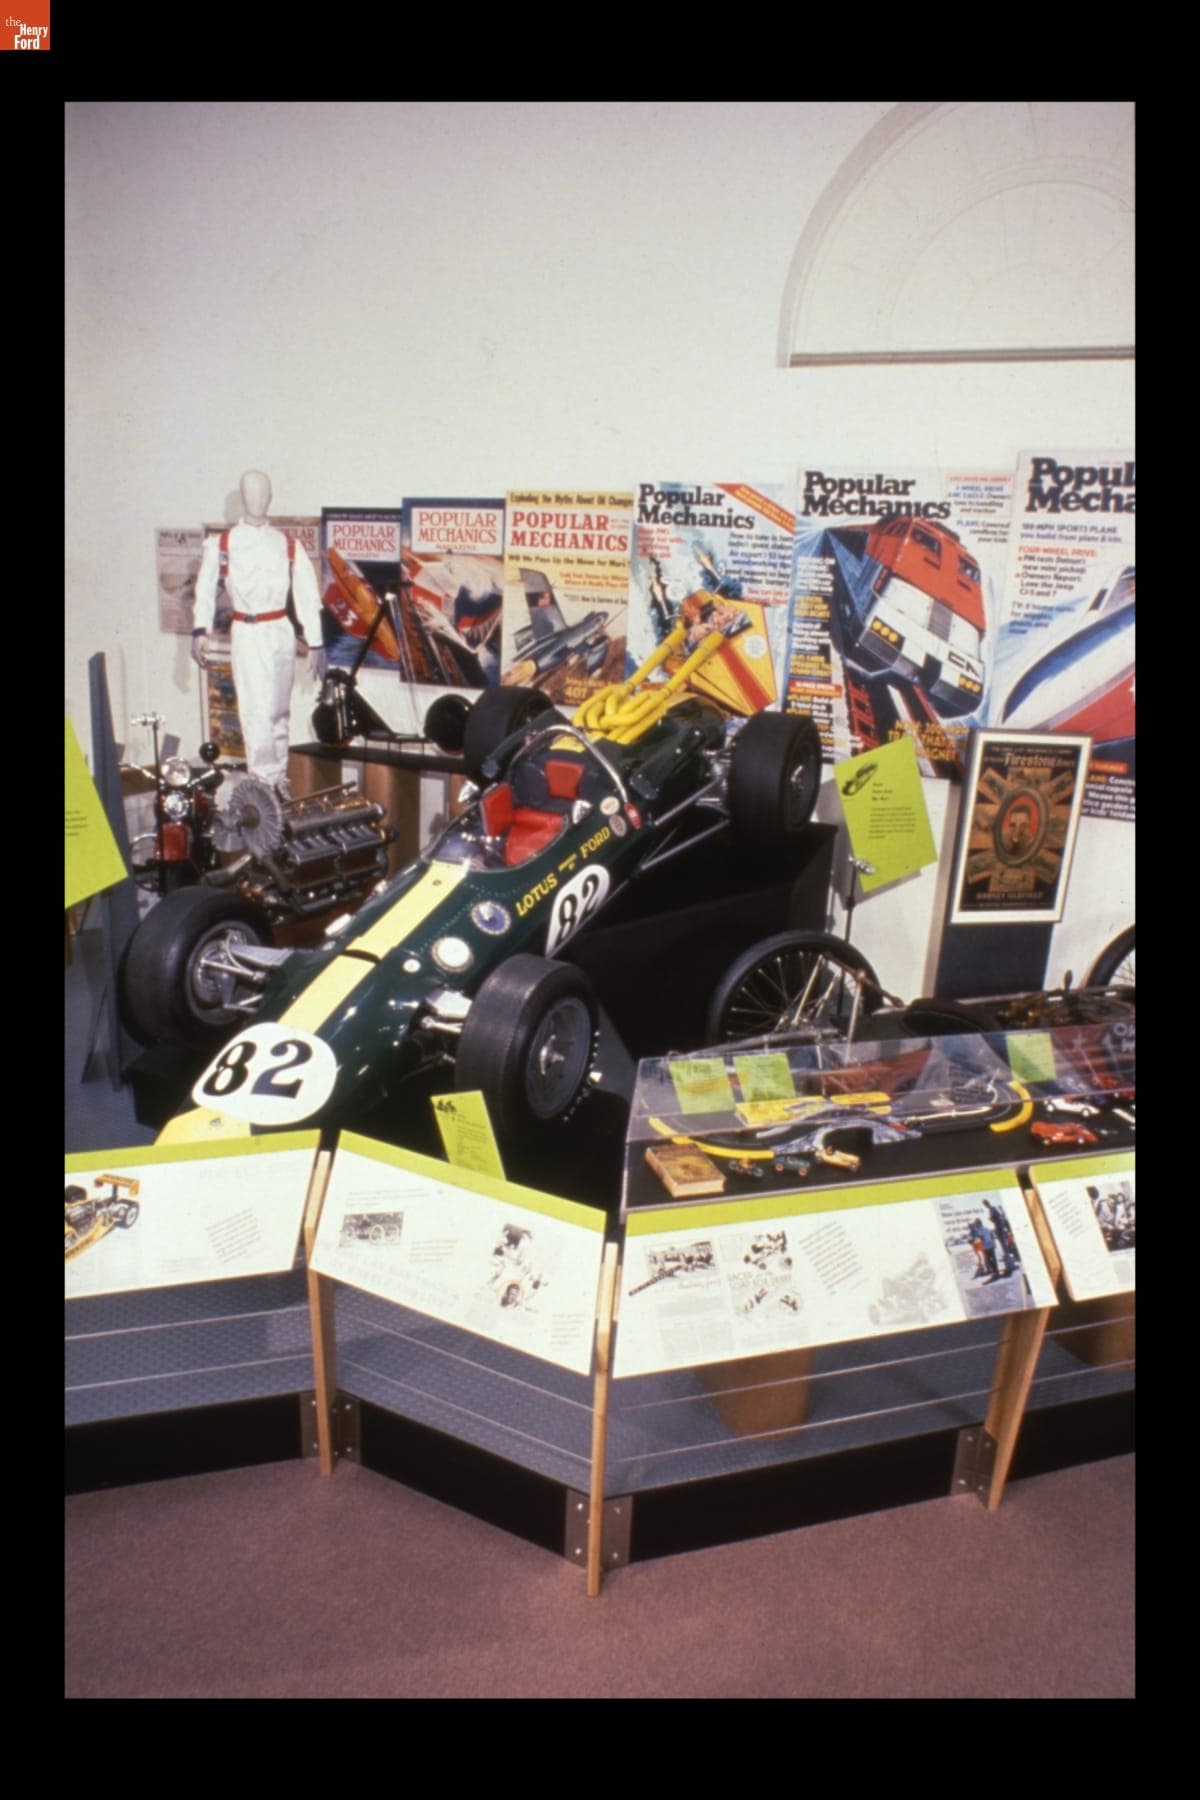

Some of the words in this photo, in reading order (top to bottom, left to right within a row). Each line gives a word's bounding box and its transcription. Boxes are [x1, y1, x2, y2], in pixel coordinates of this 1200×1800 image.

[804, 470, 916, 498] Popular
[638, 483, 726, 508] Popular
[802, 493, 951, 519] Mechanics
[418, 511, 497, 528] POPULAR
[512, 511, 609, 531] POPULAR
[637, 503, 755, 530] Mechanics
[332, 524, 395, 540] POPULAR
[417, 527, 497, 544] MECHANICS
[1036, 532, 1057, 540] build
[1089, 525, 1117, 534] PLANE
[333, 538, 396, 552] MECHANICS
[510, 530, 628, 552] MECHANICS
[1004, 751, 1057, 769] Firestone
[515, 872, 558, 917] LOTUS
[580, 826, 611, 858] FORD
[558, 872, 600, 948] 82
[202, 1039, 314, 1100] 82
